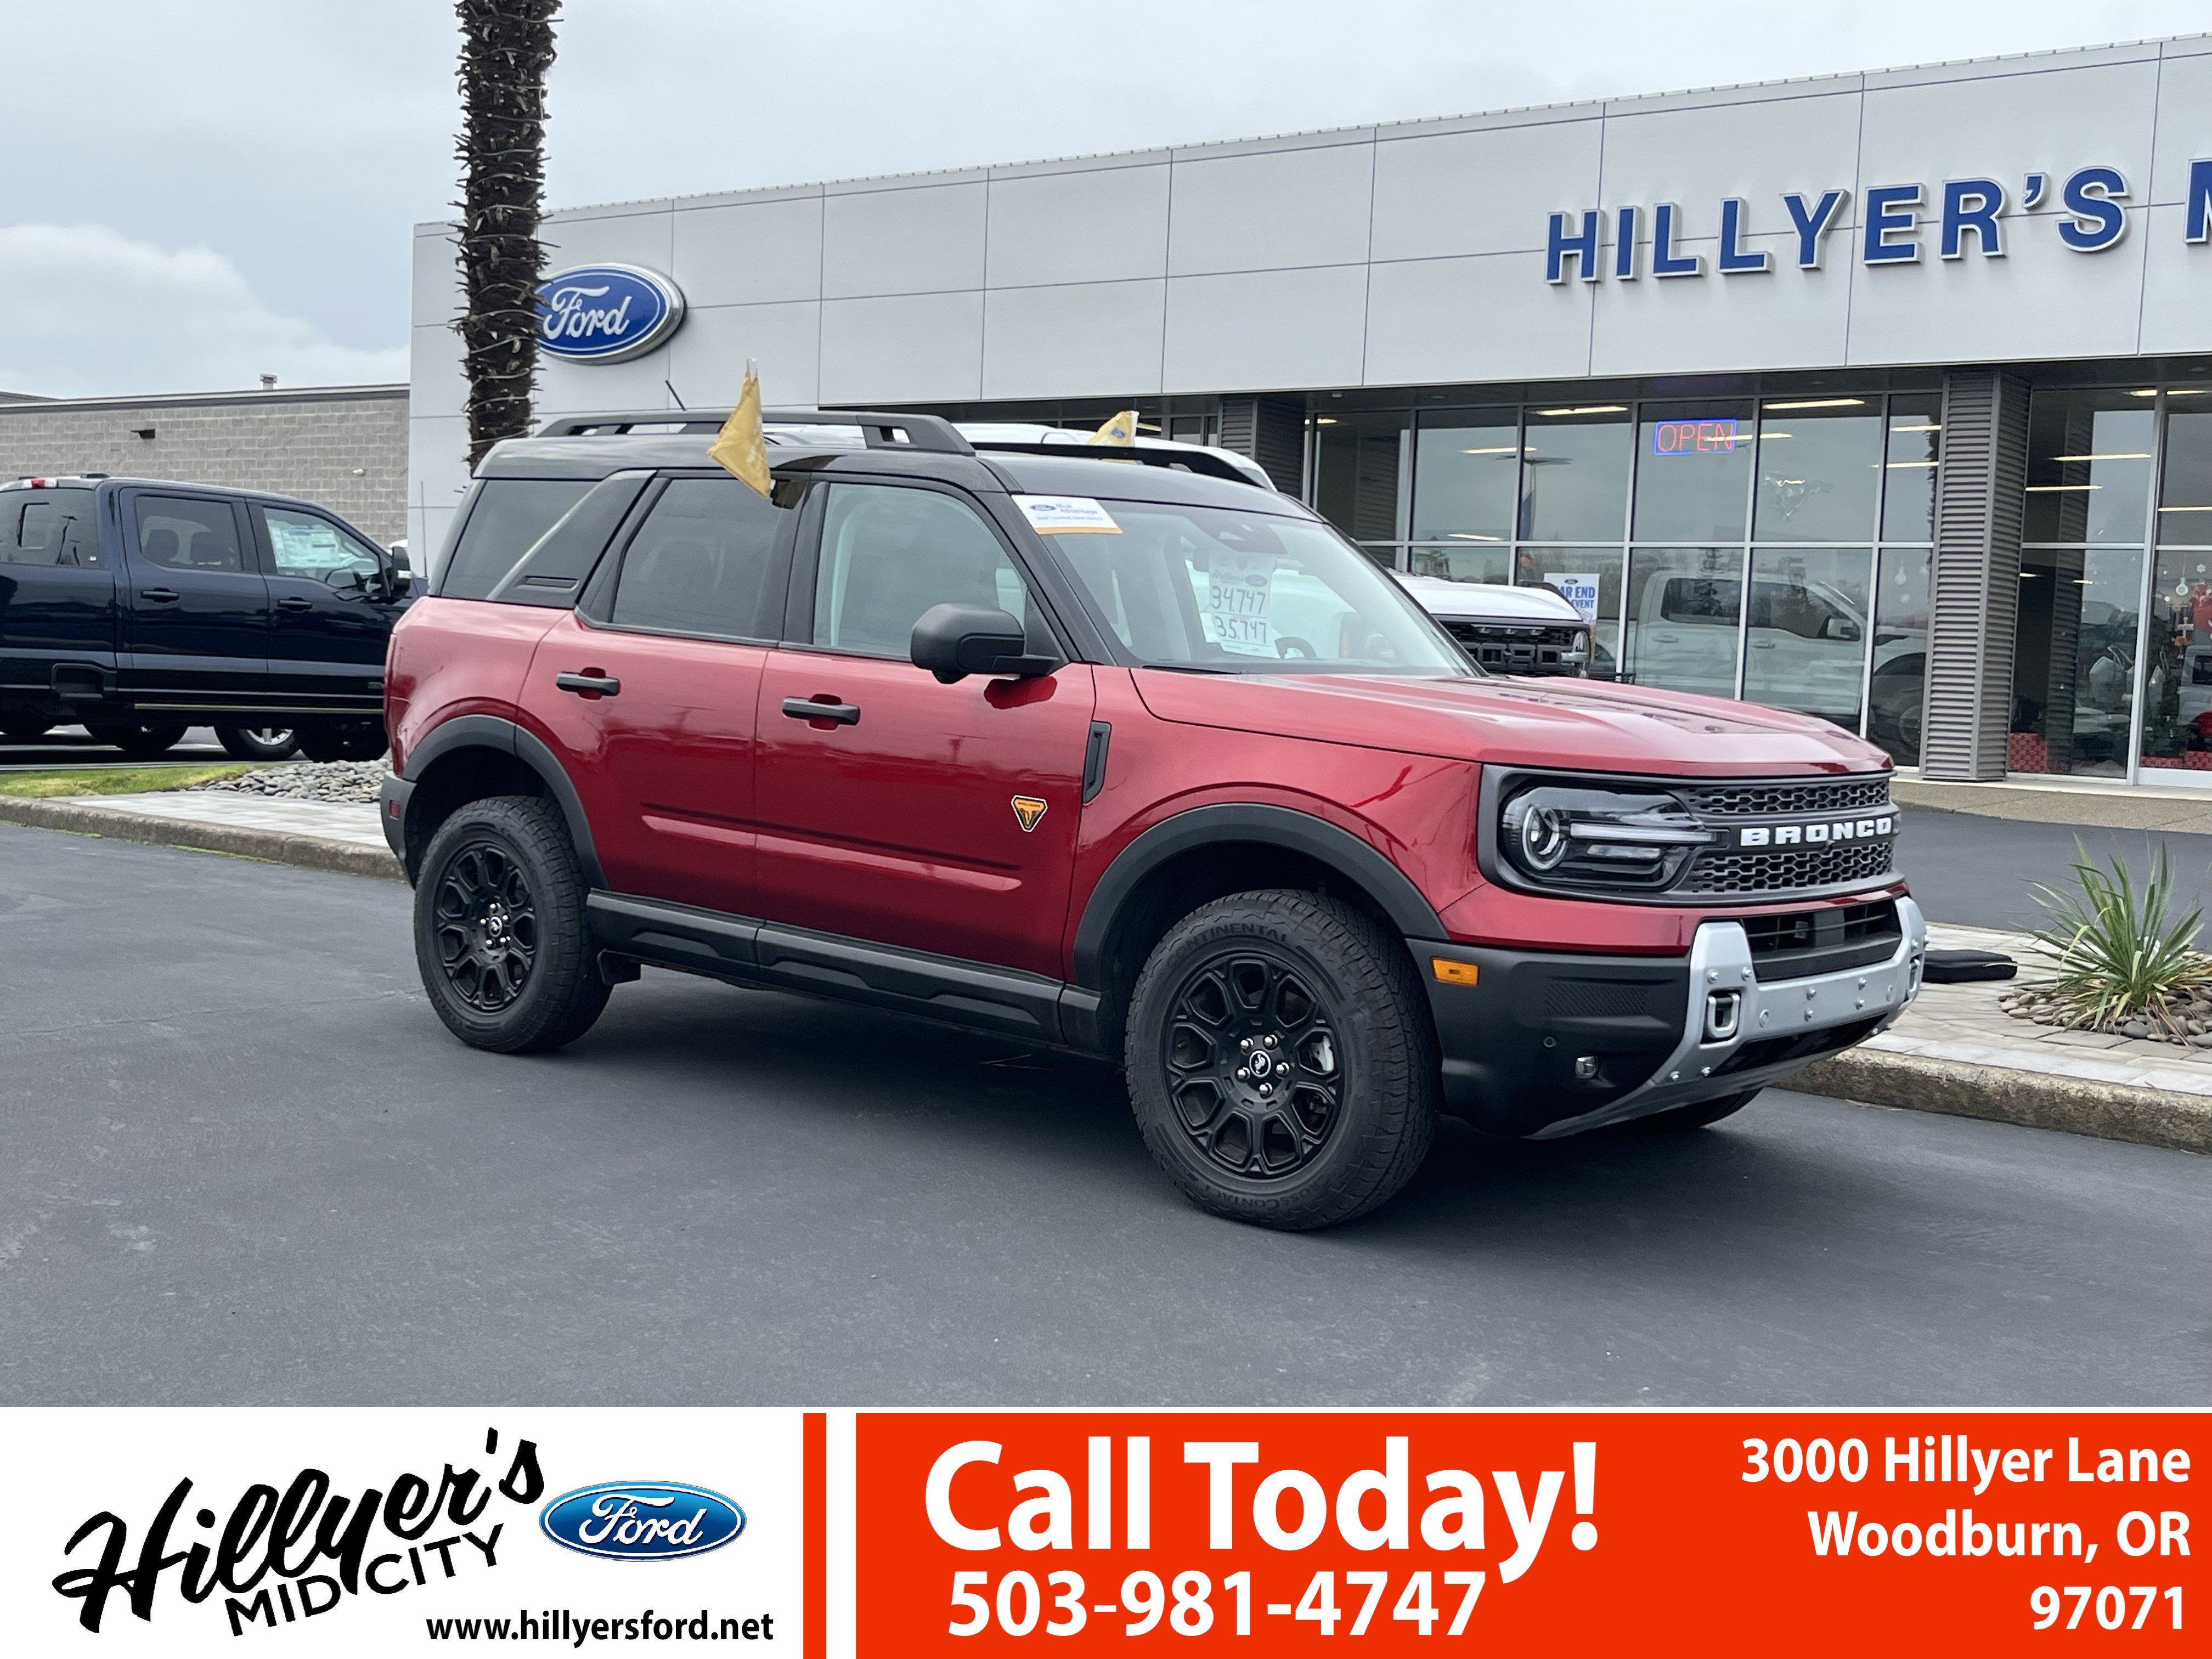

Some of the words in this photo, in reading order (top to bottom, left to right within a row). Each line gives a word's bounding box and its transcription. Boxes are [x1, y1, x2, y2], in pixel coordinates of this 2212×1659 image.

[1544, 165, 2131, 284] HILLYER'S
[543, 286, 632, 340] Ford
[1657, 423, 1734, 452] OPEN
[1575, 586, 1595, 599] END
[1740, 817, 1892, 847] BRONCO
